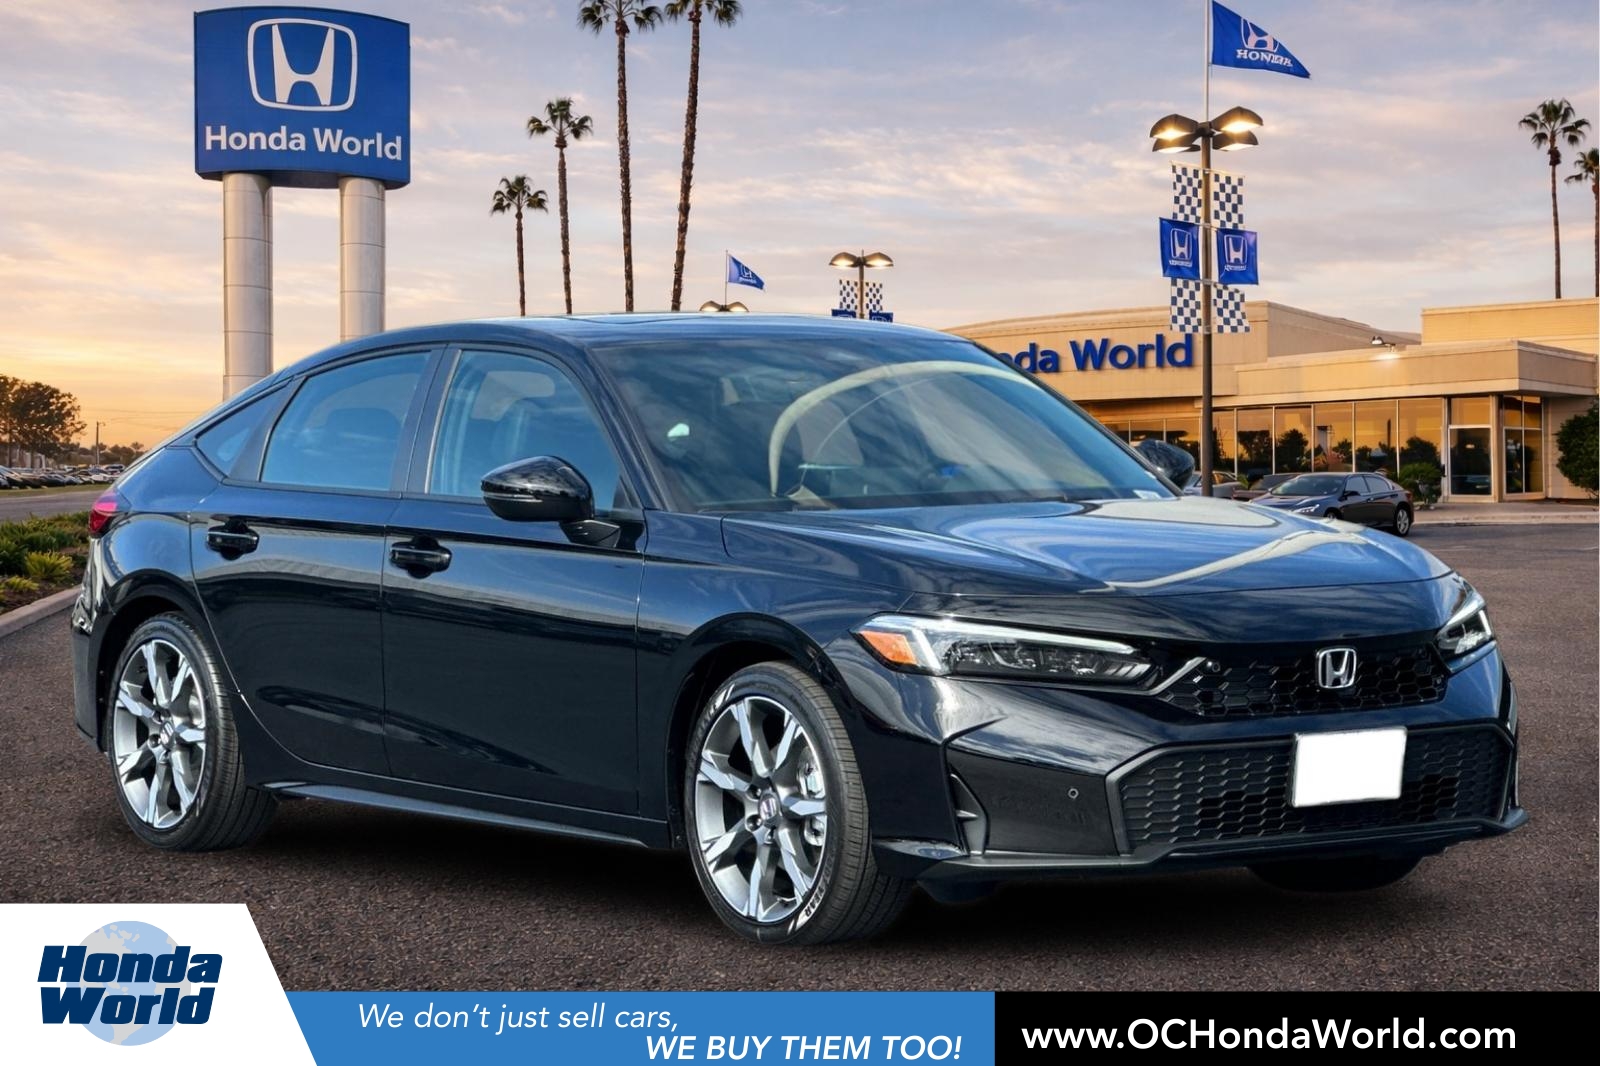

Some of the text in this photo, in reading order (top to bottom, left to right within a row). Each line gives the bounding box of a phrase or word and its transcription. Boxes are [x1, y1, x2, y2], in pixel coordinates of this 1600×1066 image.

[205, 125, 402, 161] Honda World
[1070, 333, 1193, 371] World
